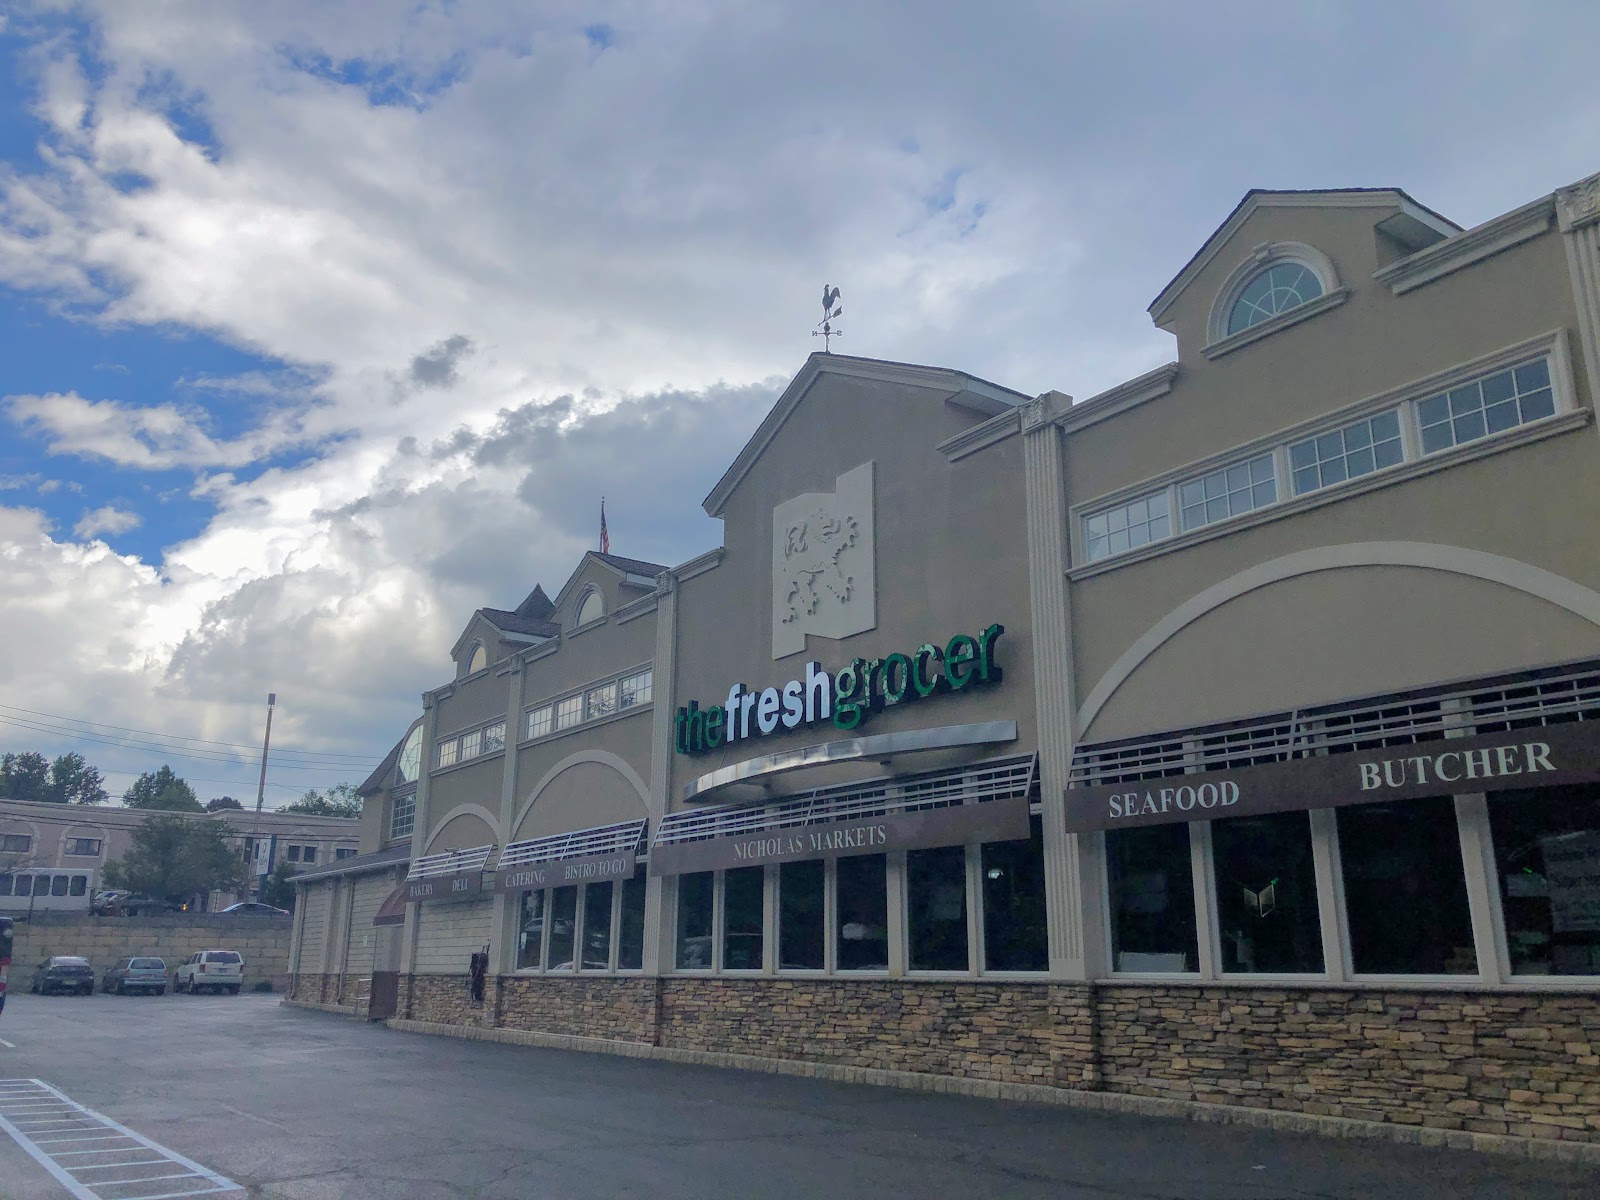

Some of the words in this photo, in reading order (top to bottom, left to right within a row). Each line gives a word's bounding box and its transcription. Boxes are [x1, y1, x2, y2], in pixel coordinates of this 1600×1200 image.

[1359, 741, 1558, 791] BUTCHER
[1108, 780, 1241, 819] SEAFOOD
[733, 834, 803, 860] NICHOLAS
[809, 825, 887, 851] MARKETS
[505, 869, 546, 888] CATERING
[564, 862, 596, 880] BISTRO
[597, 860, 610, 876] TO
[611, 858, 626, 874] GO
[409, 883, 433, 897] BAKERY
[452, 877, 469, 892] DELI
